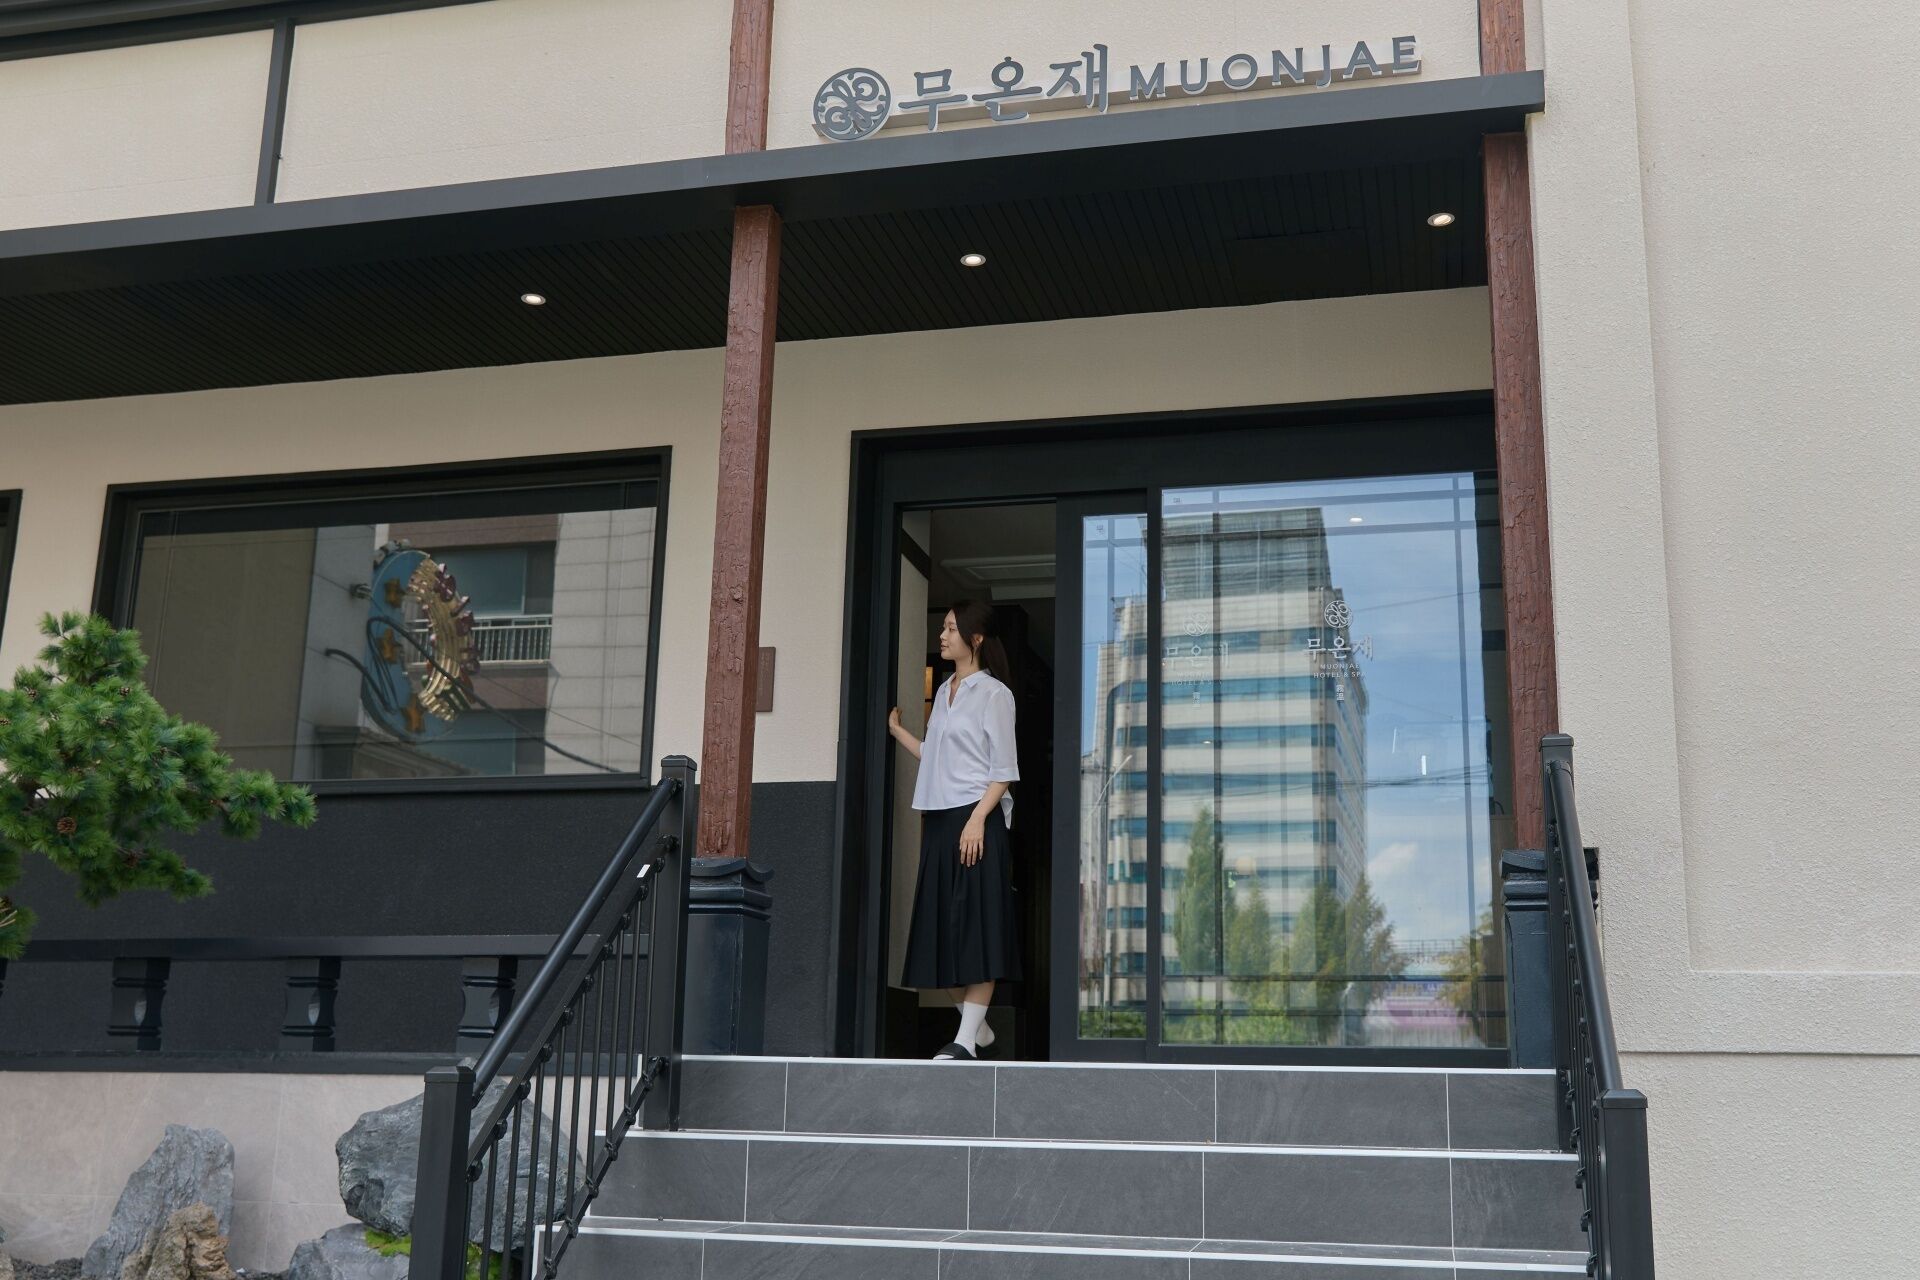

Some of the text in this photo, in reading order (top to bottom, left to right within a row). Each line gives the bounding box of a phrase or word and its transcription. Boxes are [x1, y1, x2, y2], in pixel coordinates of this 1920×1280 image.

[898, 35, 1420, 131] 무온재 MUONJAE
[1303, 635, 1373, 662] 무온재
